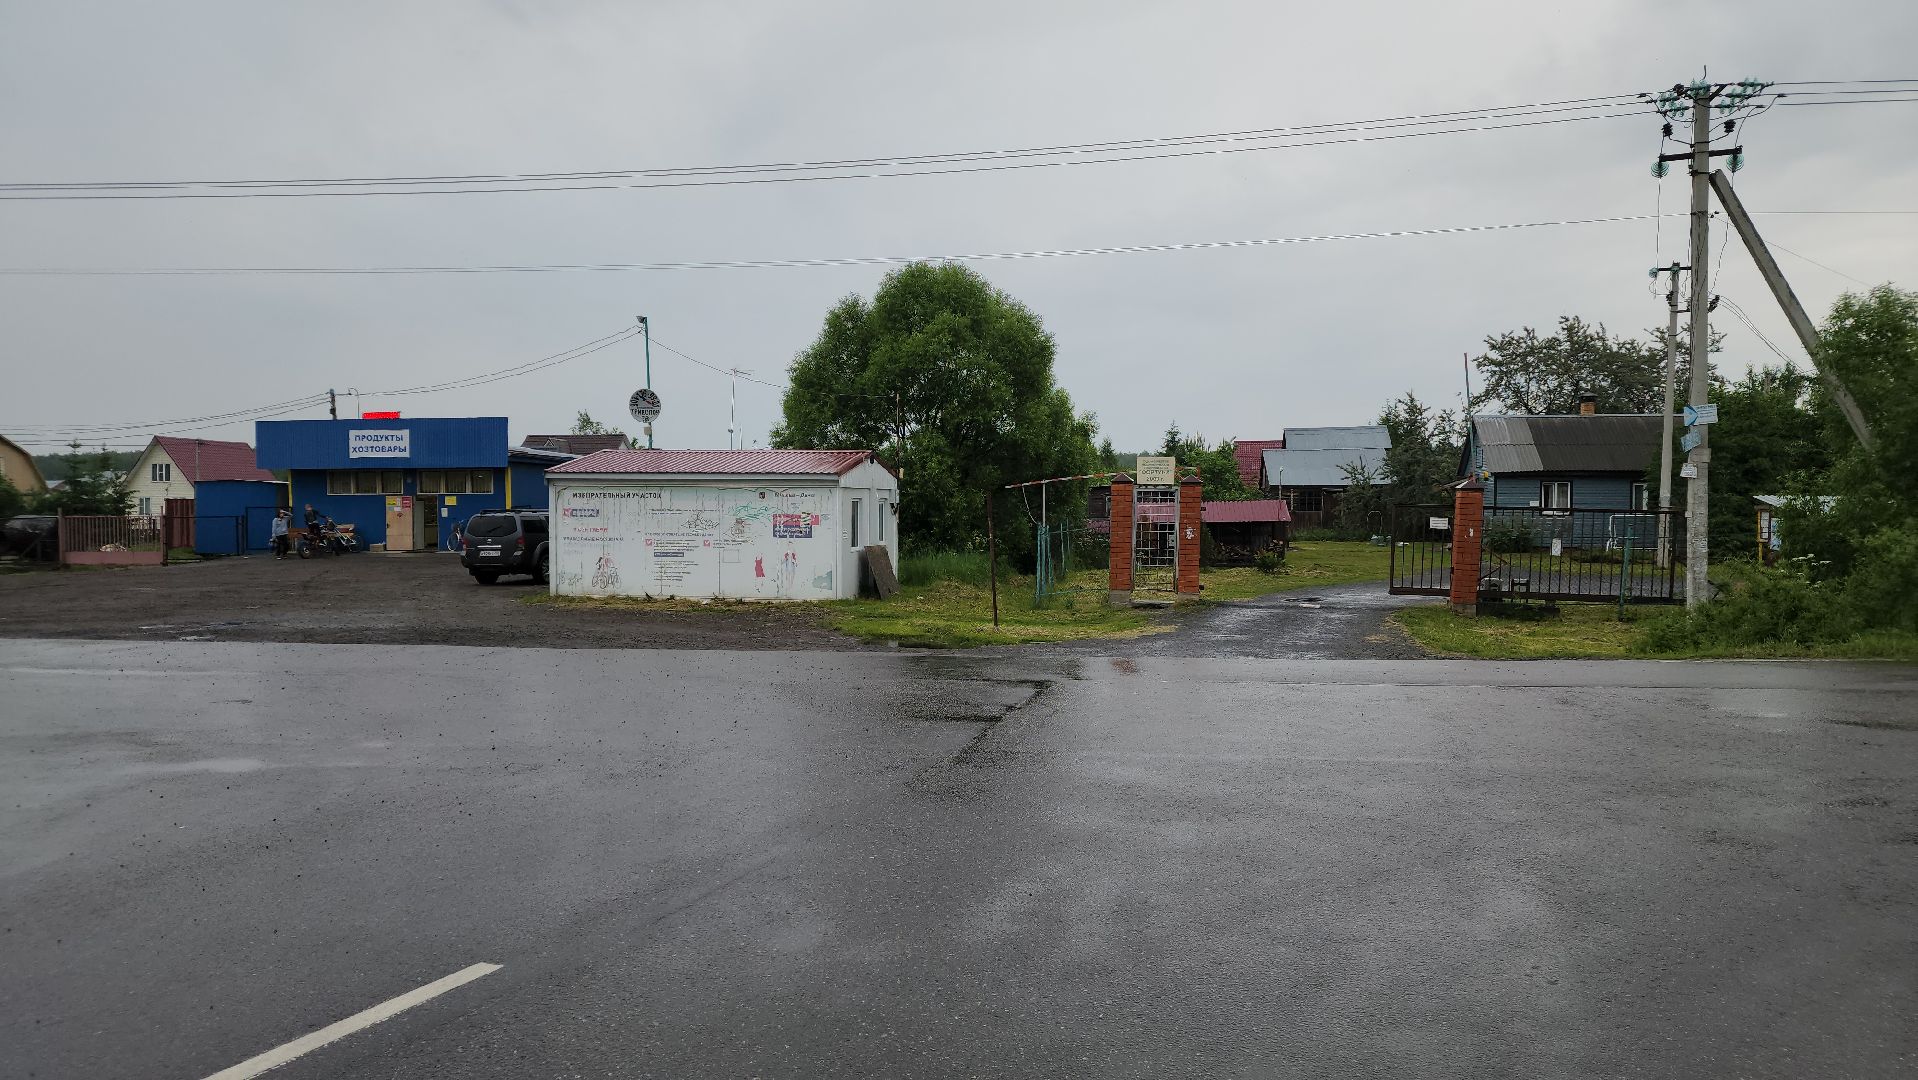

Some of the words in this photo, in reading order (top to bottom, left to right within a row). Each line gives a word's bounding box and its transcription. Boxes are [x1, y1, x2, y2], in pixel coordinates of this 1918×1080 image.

[354, 434, 404, 442] ПРОДУКТЫ
[351, 445, 407, 453] ХОЗТОВАРЫ
[572, 491, 631, 499] ИЗБИРАТЕЛЬНЫЙ
